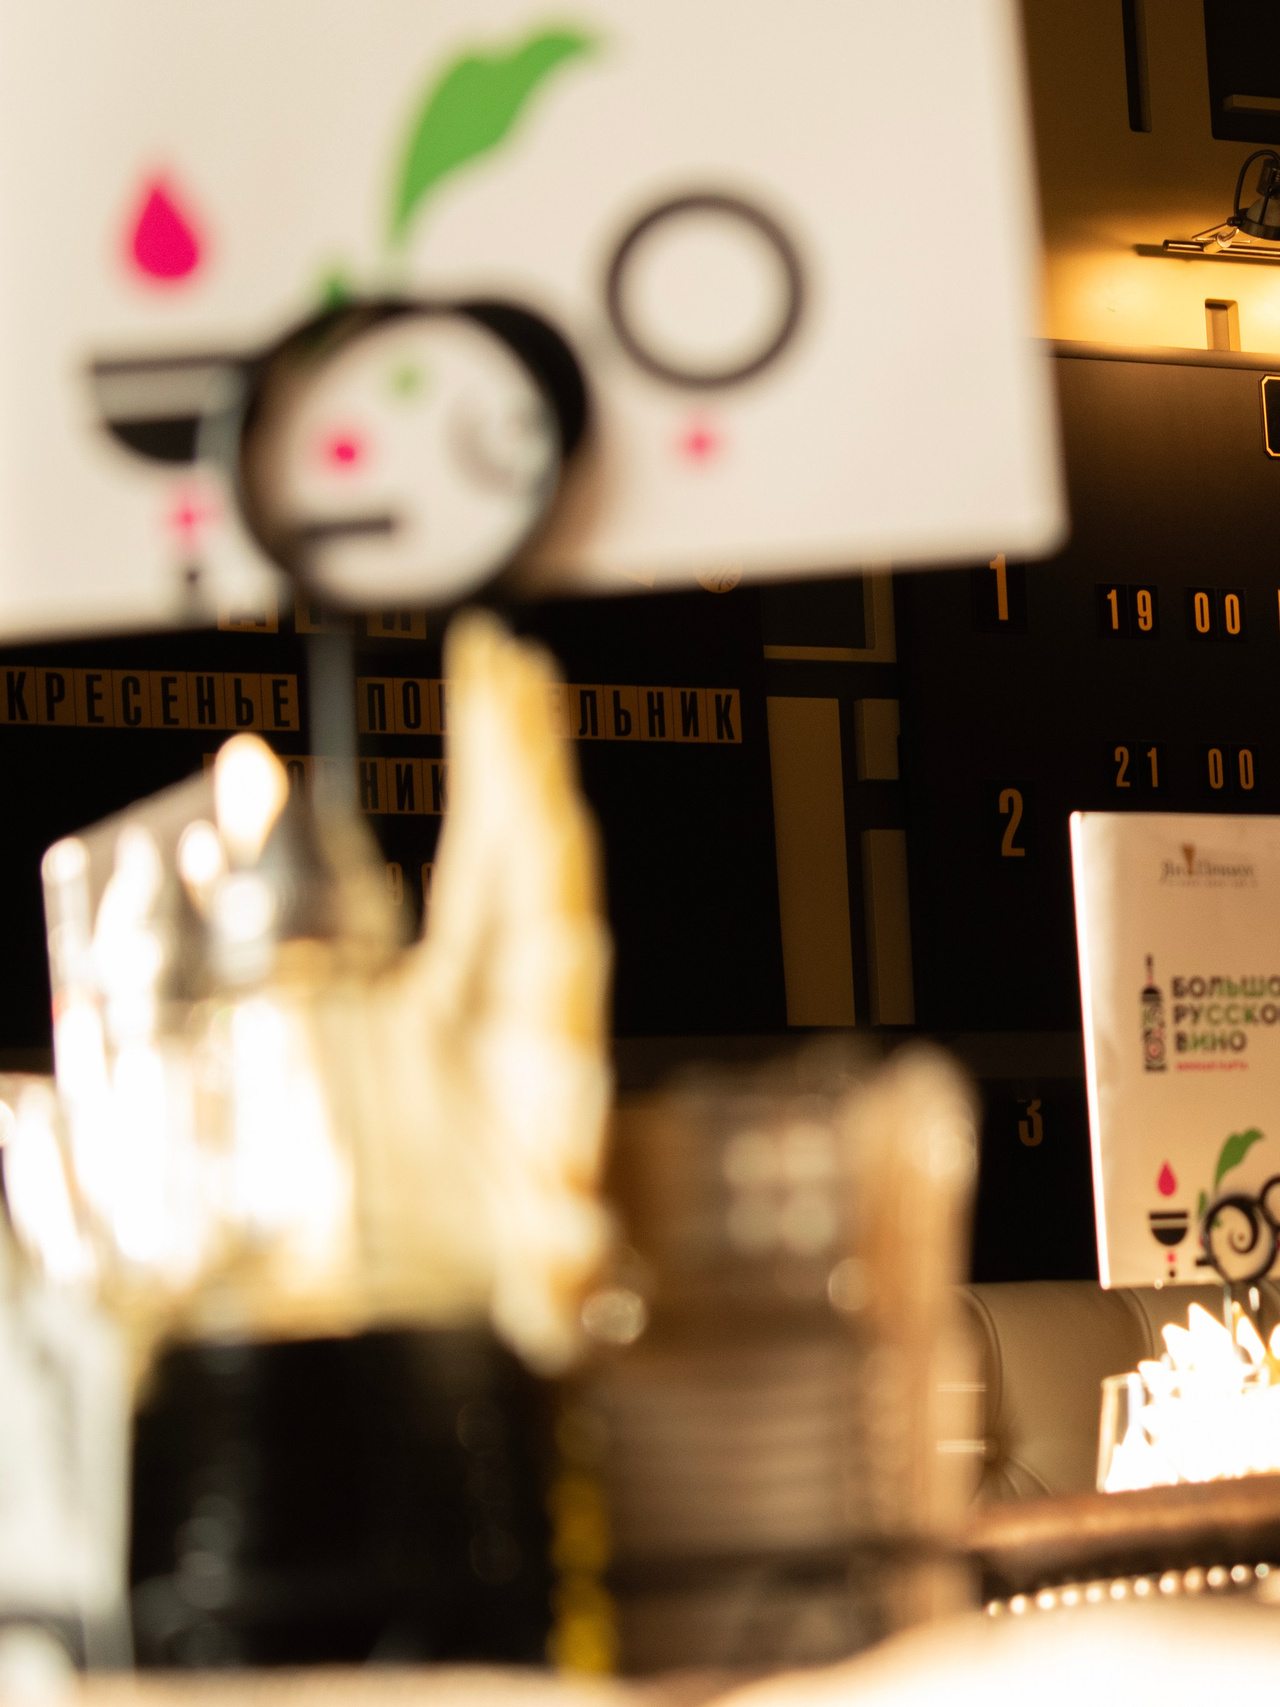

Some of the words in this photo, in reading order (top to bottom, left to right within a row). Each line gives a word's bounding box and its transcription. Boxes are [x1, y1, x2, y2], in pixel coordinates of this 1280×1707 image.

[989, 553, 1009, 621] 1
[1106, 588, 1154, 632] 19
[1193, 591, 1242, 636] 00
[1113, 745, 1160, 789] 21
[1207, 747, 1256, 791] 00
[998, 787, 1026, 858] 2
[1175, 1030, 1248, 1053] ВИНО
[1017, 1096, 1045, 1148] 3
